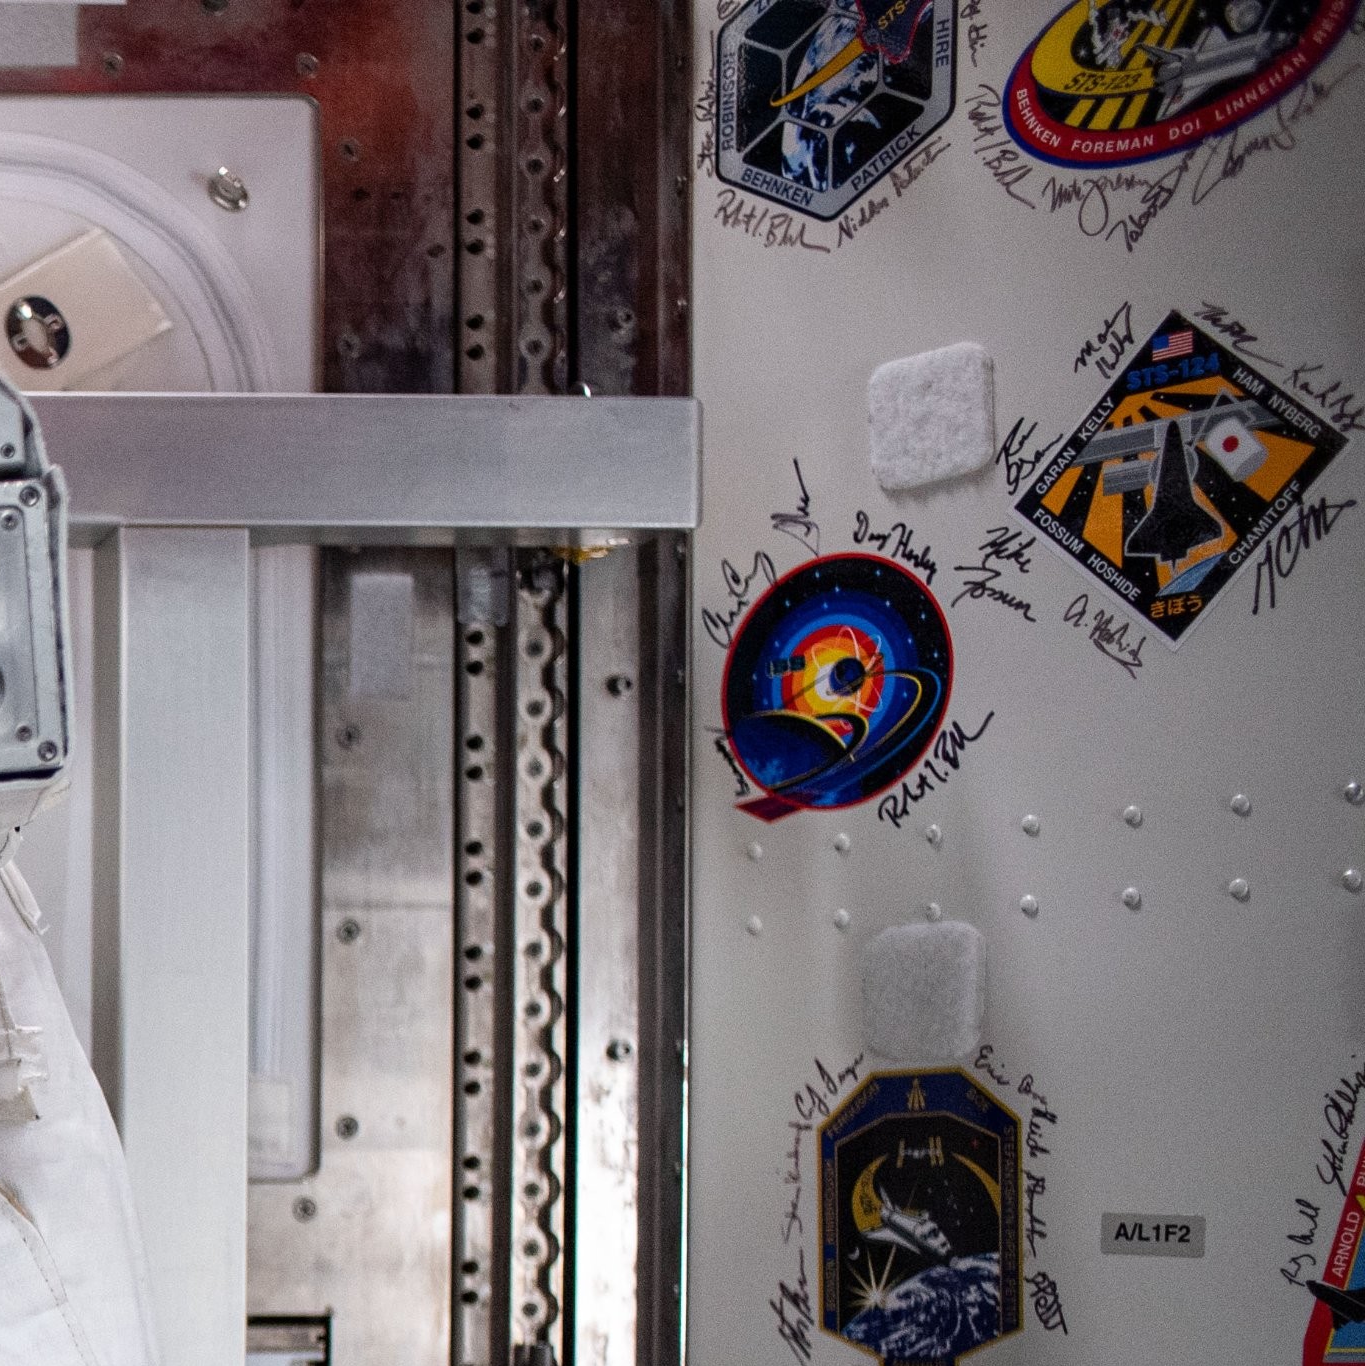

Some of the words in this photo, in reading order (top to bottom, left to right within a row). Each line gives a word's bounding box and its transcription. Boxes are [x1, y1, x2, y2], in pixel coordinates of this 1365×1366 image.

[935, 18, 950, 68] HIRE
[1016, 88, 1061, 148] BEHNKEN
[1071, 135, 1153, 154] FOREMAN
[1171, 119, 1201, 140] DOI
[1215, 52, 1308, 123] LINNEHAN
[1065, 72, 1142, 92] STS-123
[741, 168, 814, 206] BEHNKEN
[851, 124, 921, 190] PATRICK
[1125, 354, 1219, 390] STS-124
[1233, 368, 1265, 396] HAM
[1268, 394, 1321, 440] NYBERG
[1035, 446, 1077, 495] GARAN
[1079, 396, 1115, 442] KELLY
[1032, 508, 1084, 555] FOSSUM
[1086, 554, 1142, 602] HOSHIDE
[1229, 480, 1302, 565] CHAMITOFF
[1149, 594, 1203, 619] きぼう
[1115, 1222, 1191, 1243] A/L1F2
[1331, 1210, 1361, 1278] ARNOLD
